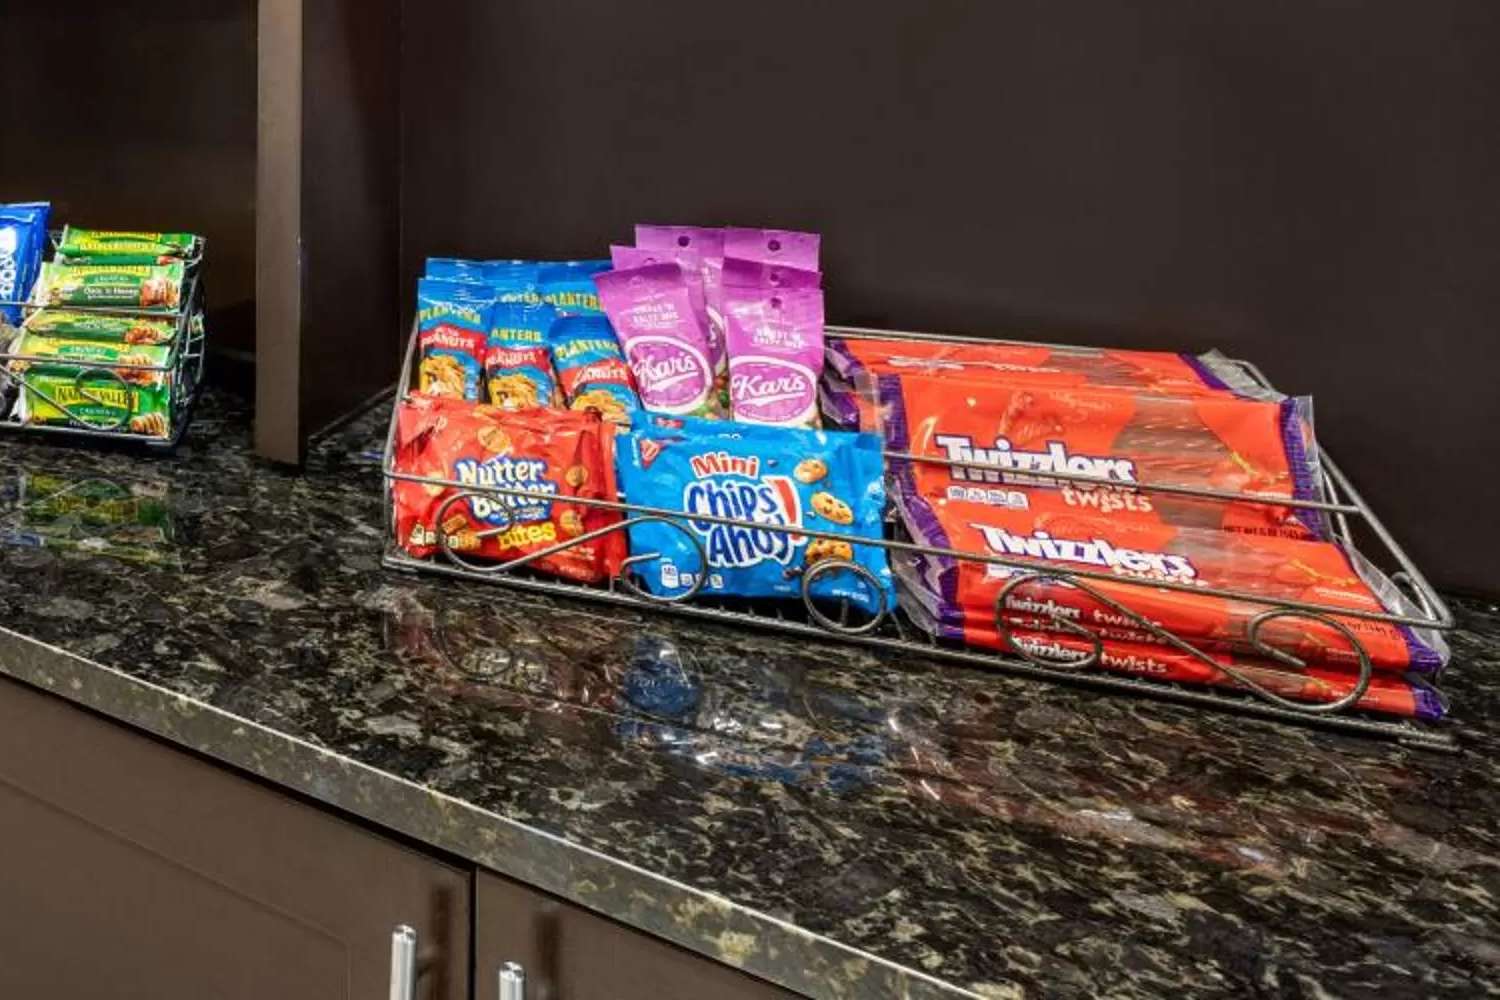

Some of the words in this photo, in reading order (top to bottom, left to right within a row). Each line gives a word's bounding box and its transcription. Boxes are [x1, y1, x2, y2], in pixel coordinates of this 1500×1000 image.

[457, 459, 545, 486] Nutter
[691, 453, 759, 479] Mini
[687, 483, 780, 532] Chips
[1063, 485, 1154, 512] twists
[969, 523, 1198, 578] Twizzlers
[1101, 652, 1168, 674] twists
